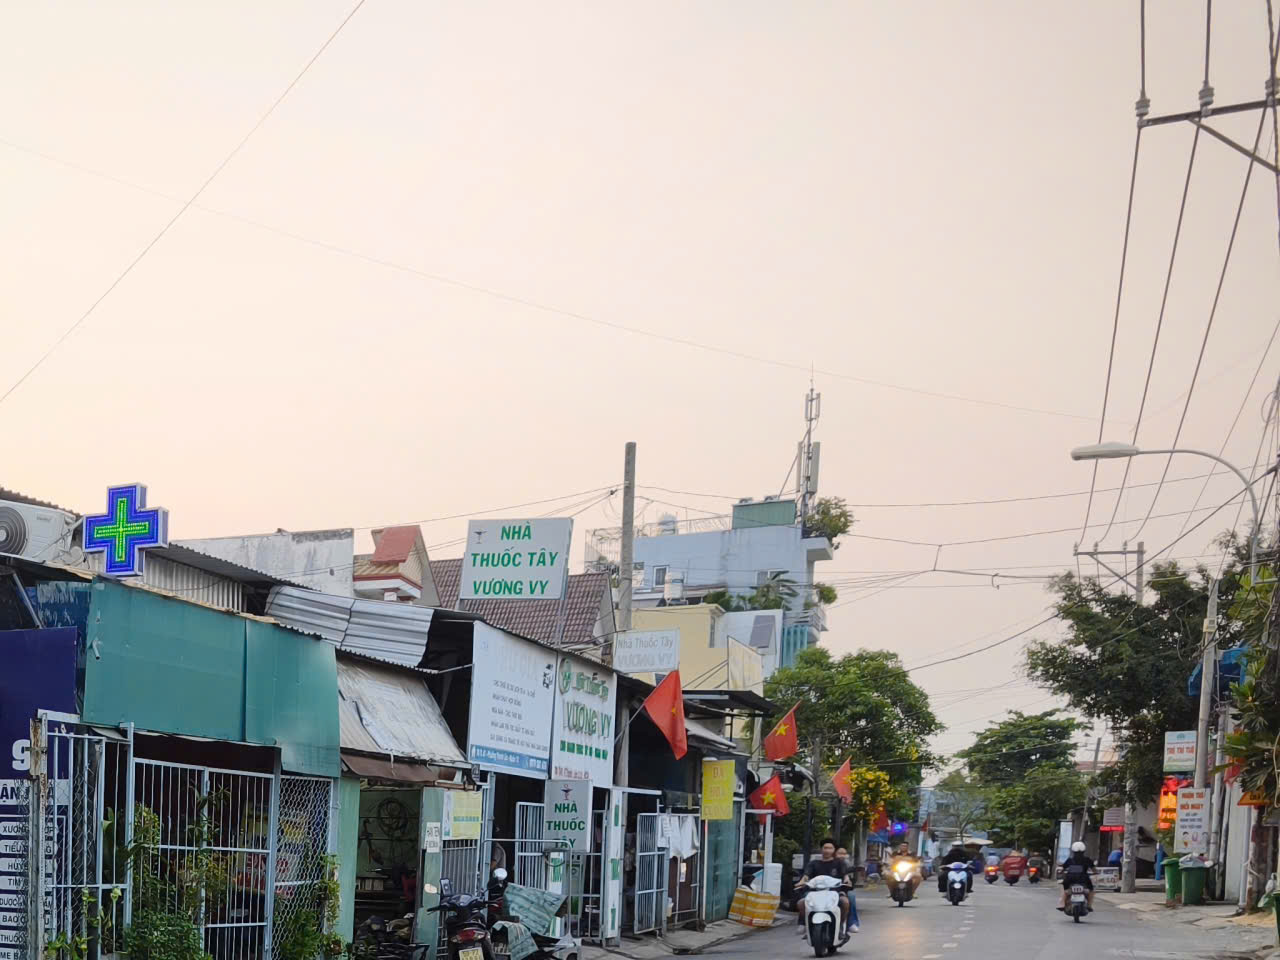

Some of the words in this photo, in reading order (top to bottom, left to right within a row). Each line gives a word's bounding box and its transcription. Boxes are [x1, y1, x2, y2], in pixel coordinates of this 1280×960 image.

[501, 521, 532, 541] NHÀ
[471, 546, 523, 568] THUỐC
[527, 547, 559, 567] TÂY
[473, 578, 524, 595] VƯƠNG
[529, 579, 549, 595] VY
[12, 739, 31, 771] 9
[554, 800, 578, 813] NHÀ
[545, 816, 586, 831] THUỐC
